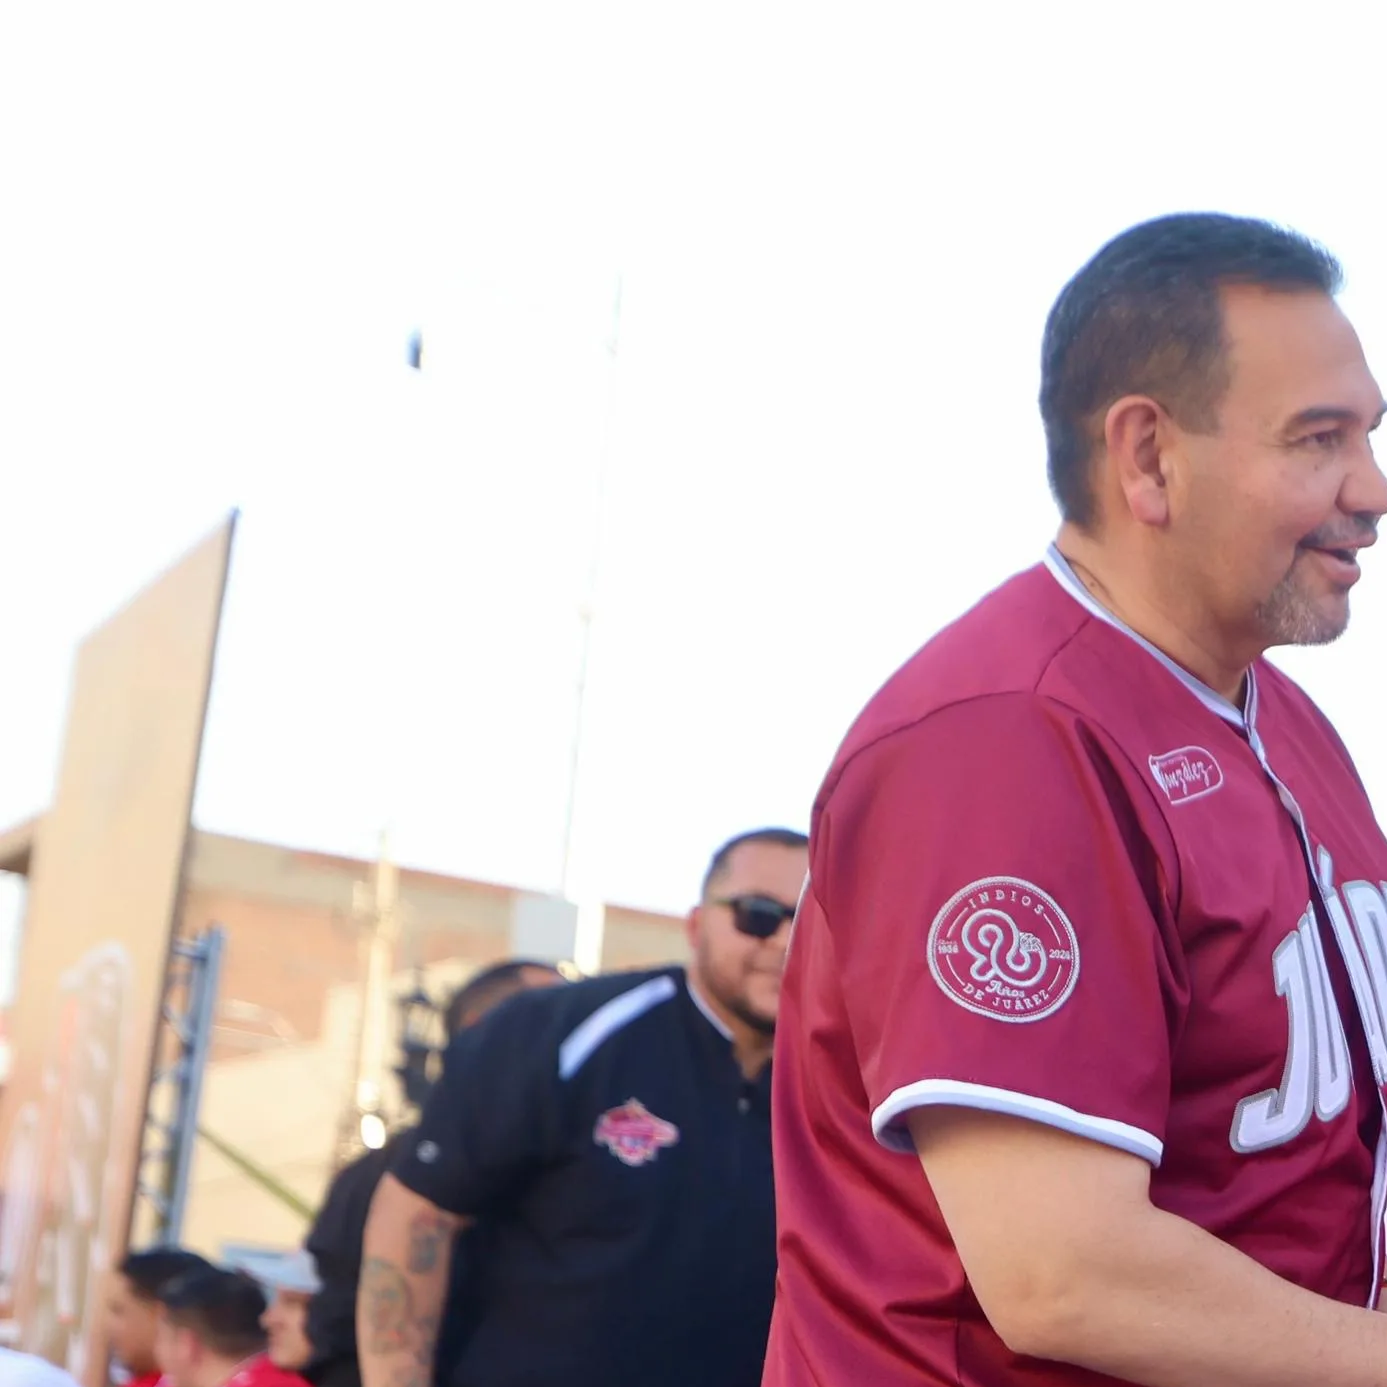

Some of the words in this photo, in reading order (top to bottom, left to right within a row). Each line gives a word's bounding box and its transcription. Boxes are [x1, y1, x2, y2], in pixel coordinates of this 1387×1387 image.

[968, 889, 1044, 915] INDIOS
[963, 983, 985, 1000] DE
[992, 989, 1049, 1010] JUÁREZ
